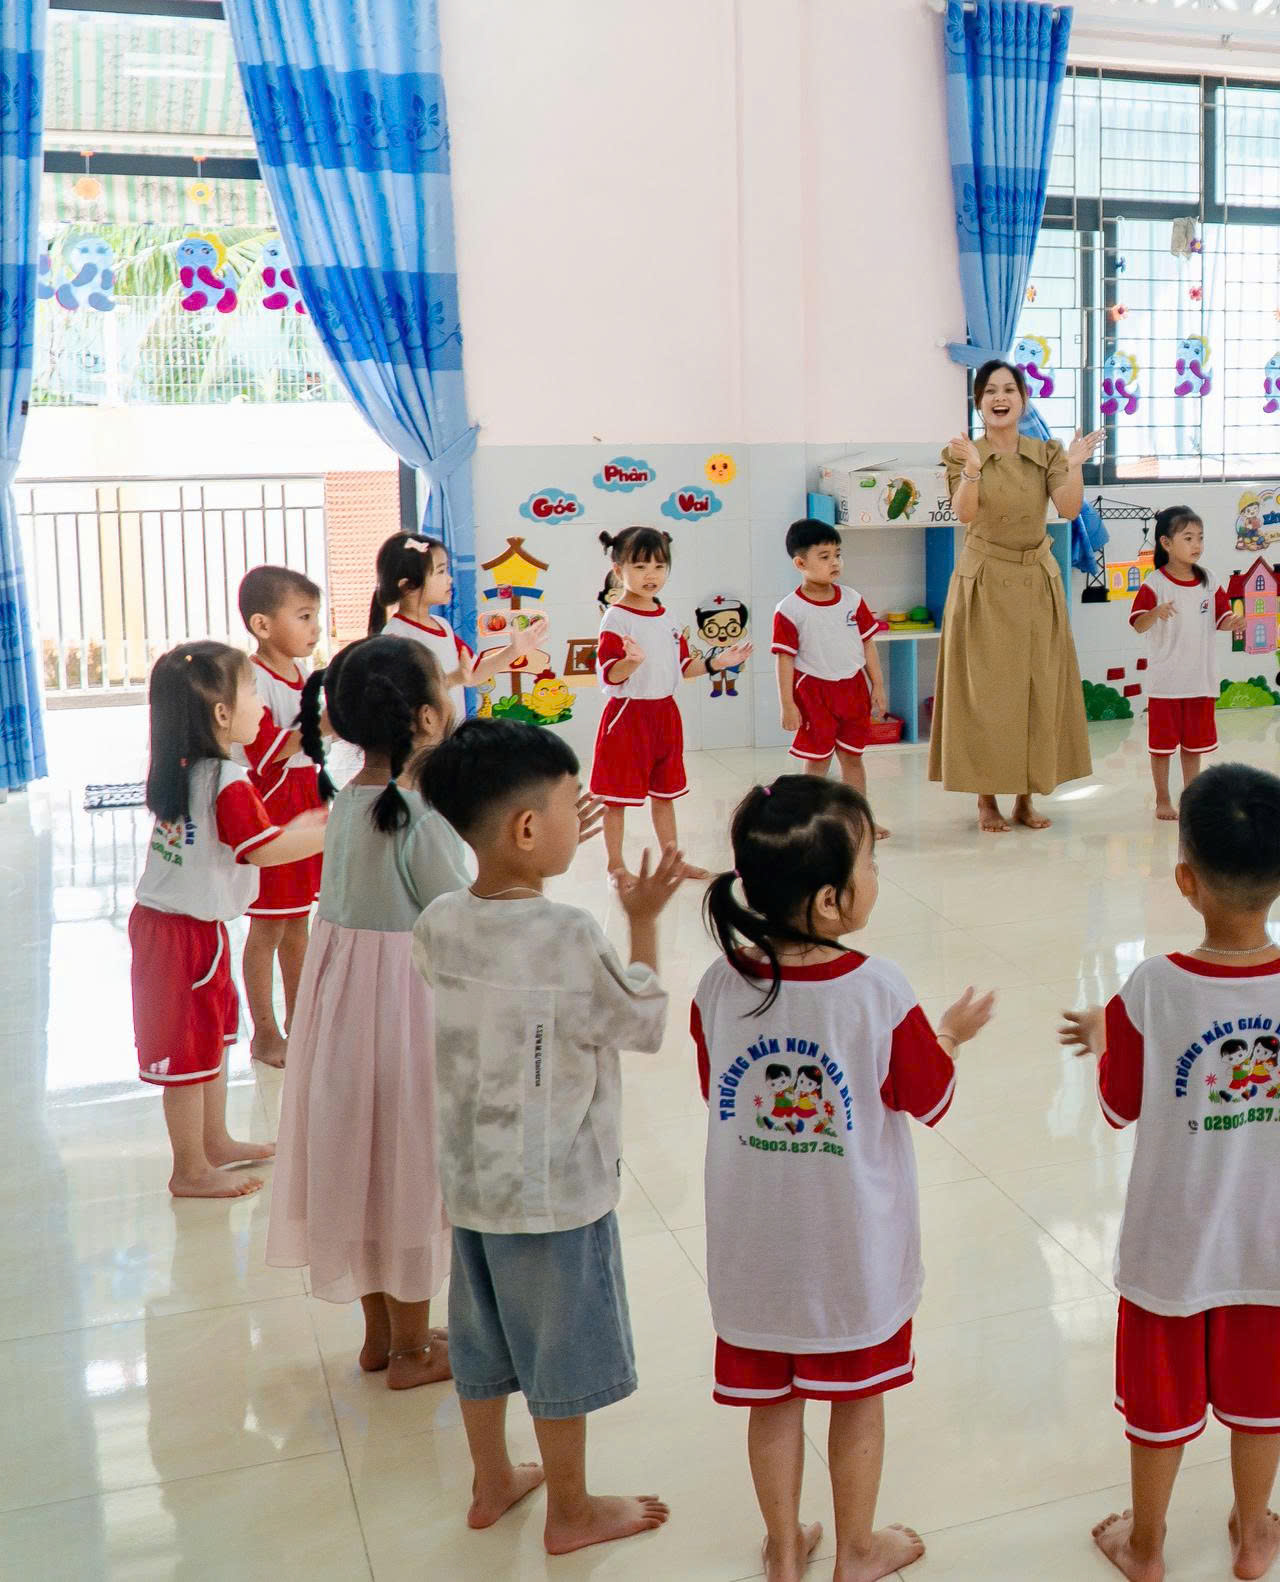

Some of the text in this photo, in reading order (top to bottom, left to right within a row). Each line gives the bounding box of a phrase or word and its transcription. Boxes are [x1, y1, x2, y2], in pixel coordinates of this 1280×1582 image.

[532, 465, 709, 518] Góc Phân Vai
[718, 1056, 750, 1121] TRƯỜNG
[786, 1037, 820, 1058] NON
[820, 1052, 844, 1086] HOA
[1176, 1042, 1203, 1098] TRƯỜNG
[1238, 1014, 1272, 1030] GIÁO
